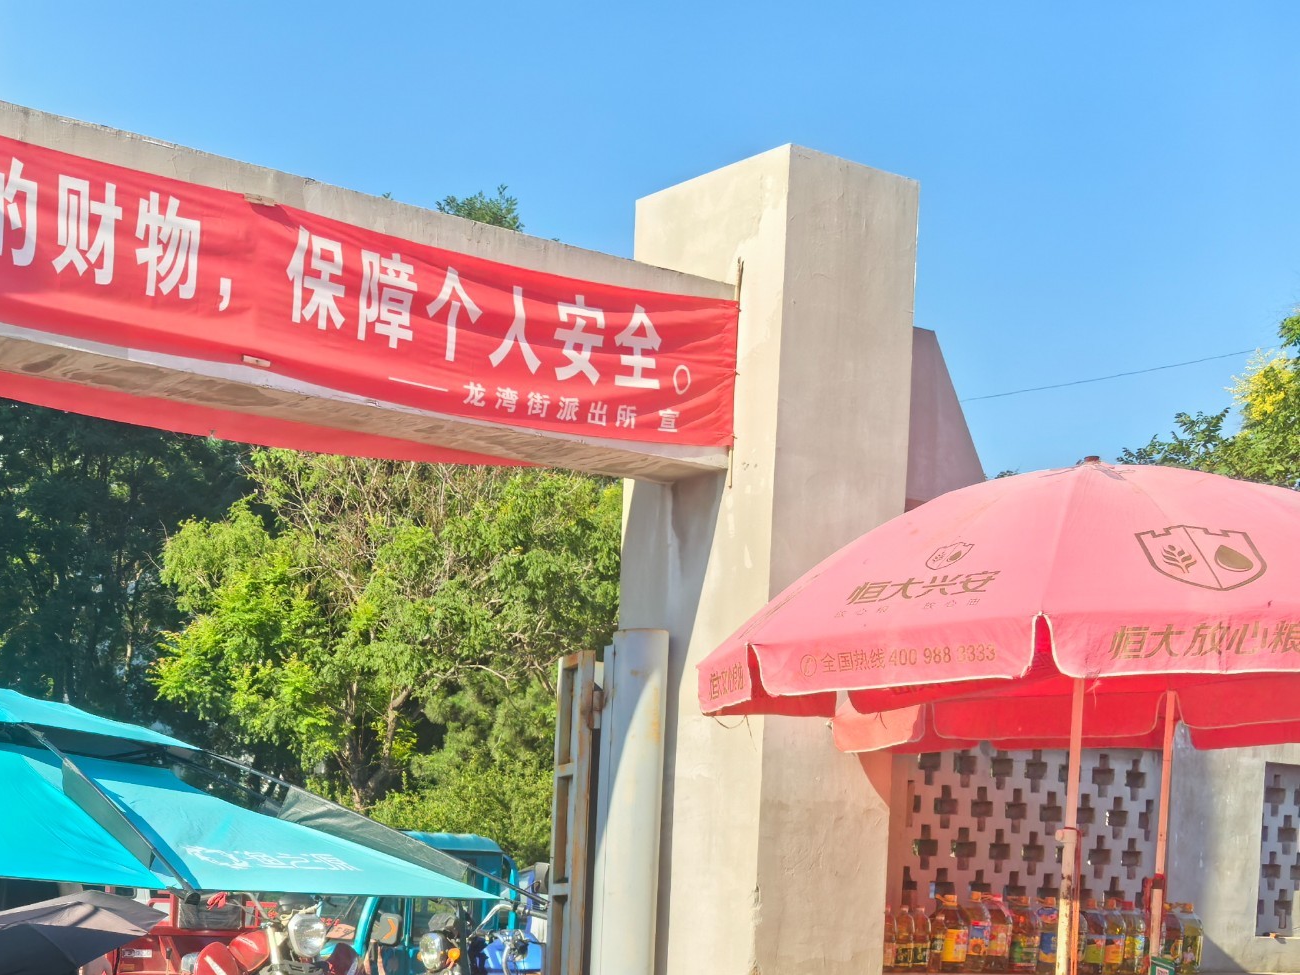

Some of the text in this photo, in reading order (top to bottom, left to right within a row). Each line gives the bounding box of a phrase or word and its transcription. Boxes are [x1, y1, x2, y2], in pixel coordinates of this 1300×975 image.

[657, 409, 680, 433] 宣
[846, 570, 1001, 606] 恒大兴安
[821, 643, 996, 673] 全国热线 400 988 3333
